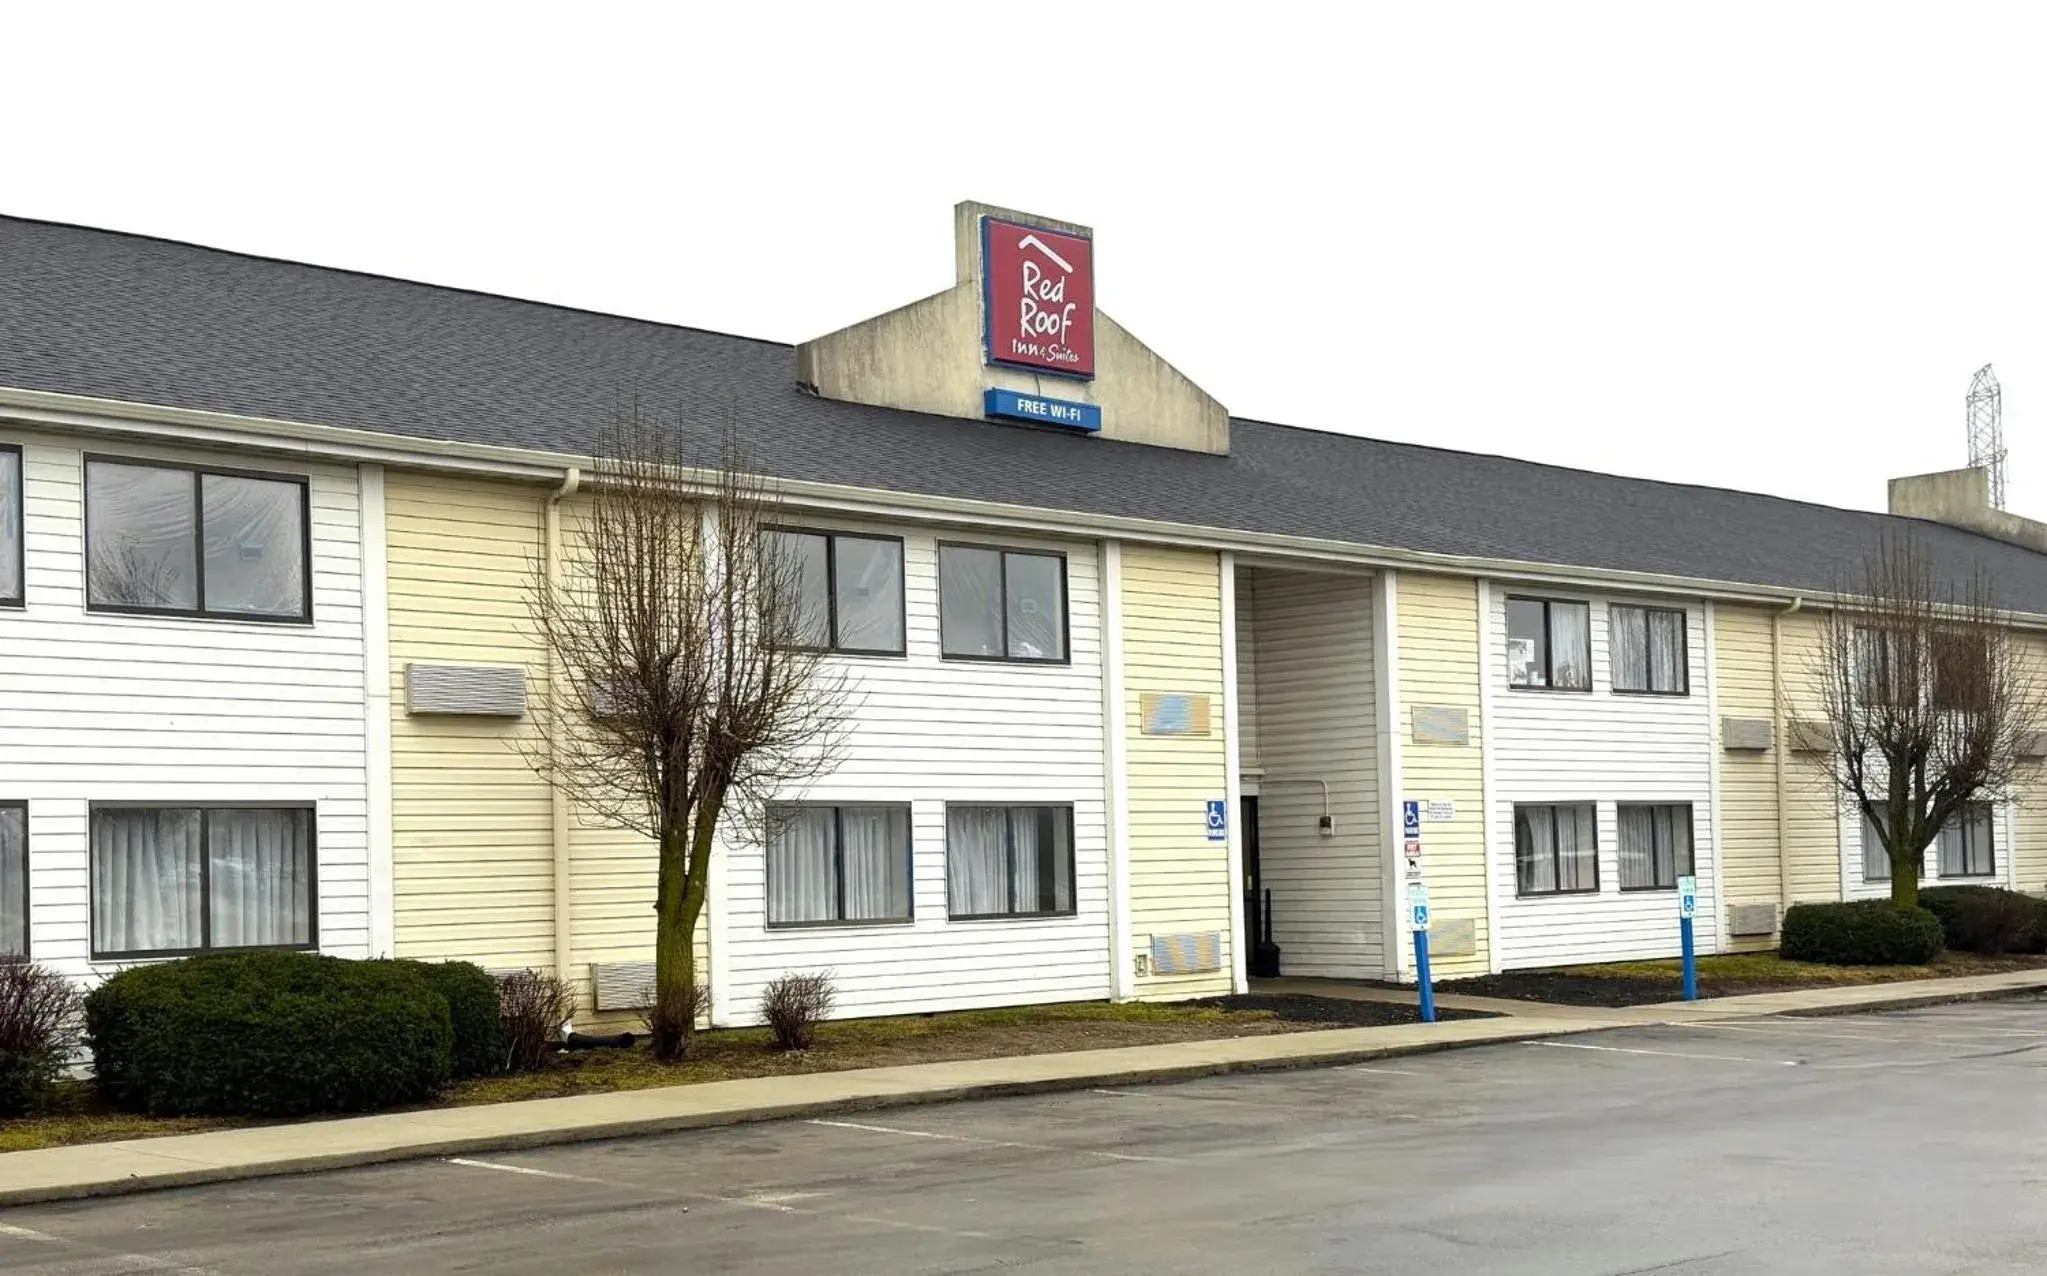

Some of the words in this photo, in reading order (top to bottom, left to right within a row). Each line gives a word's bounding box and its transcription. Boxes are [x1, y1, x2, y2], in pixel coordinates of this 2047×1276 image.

[1023, 260, 1065, 303] Red
[1020, 297, 1076, 345] Roof
[1012, 338, 1038, 356] Inn
[1046, 343, 1080, 363] Suites
[1017, 398, 1047, 416] FREE
[1050, 404, 1081, 422] WI-FI
